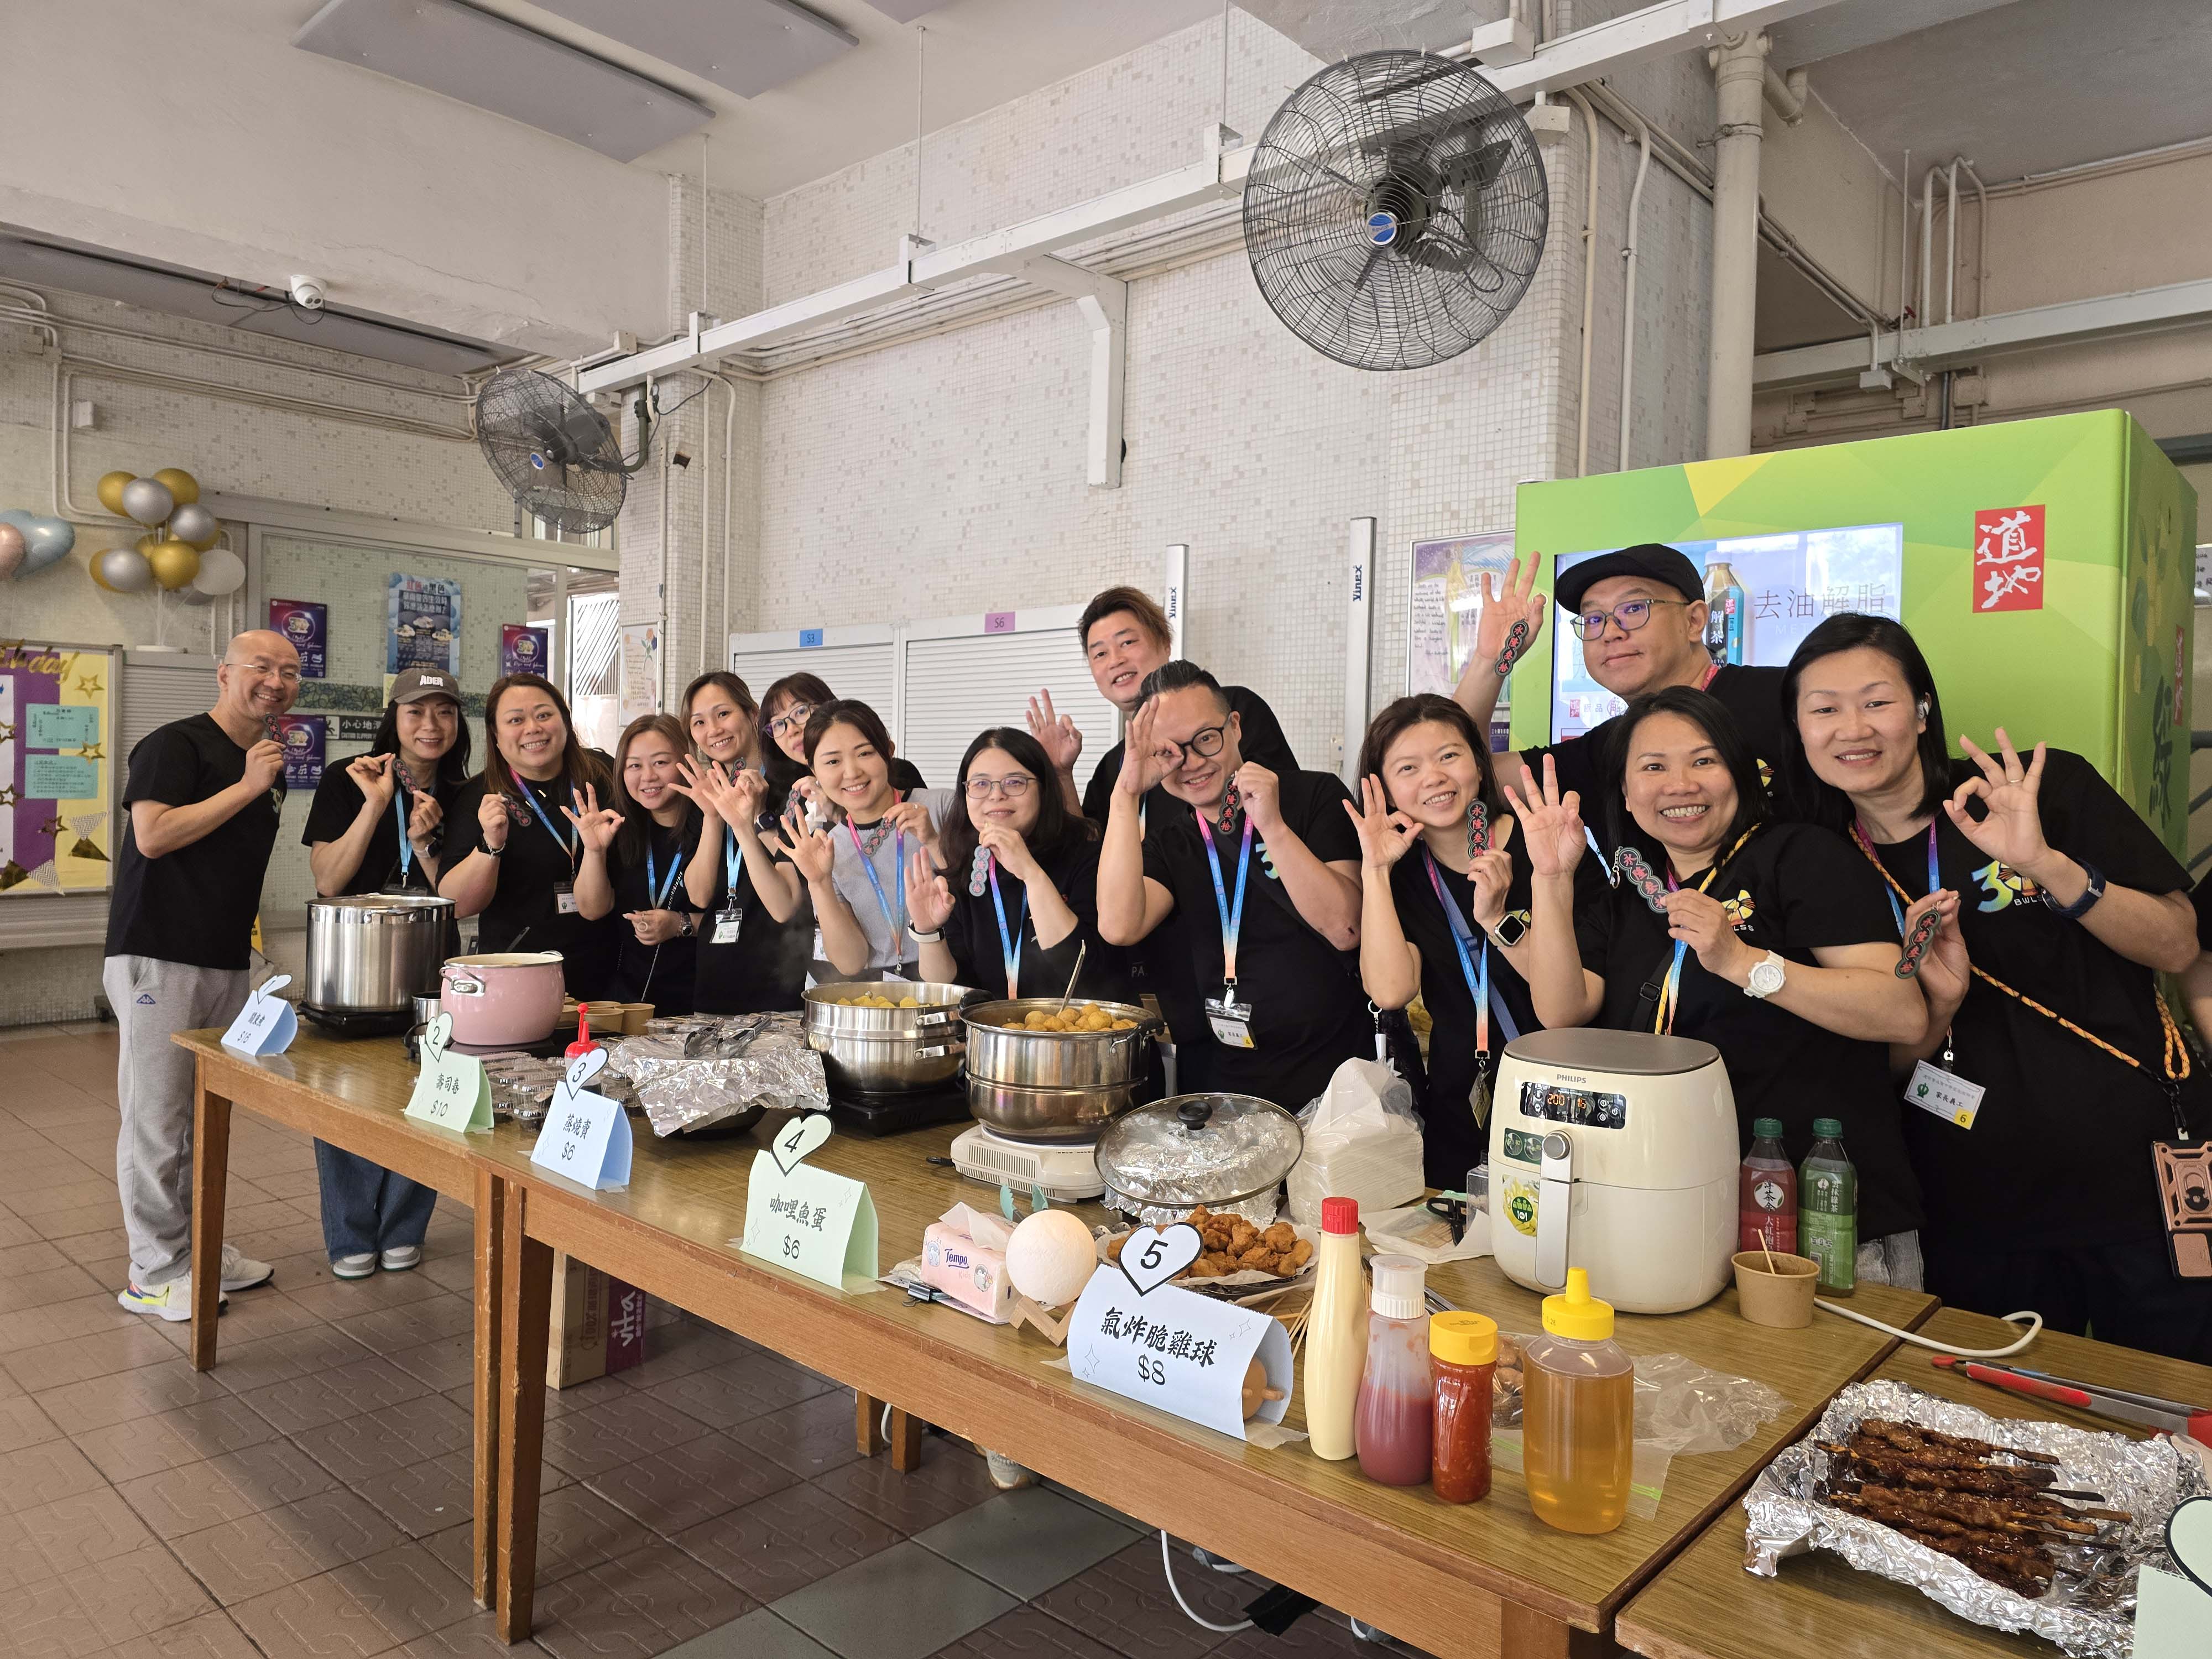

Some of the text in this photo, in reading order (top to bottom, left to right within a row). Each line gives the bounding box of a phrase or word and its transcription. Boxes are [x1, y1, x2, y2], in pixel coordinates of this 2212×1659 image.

[1976, 510, 2042, 609] 道地
[1352, 564, 1362, 602] Vinex
[994, 617, 1004, 628] S6
[806, 634, 815, 643] S3
[419, 675, 444, 687] ADER
[2014, 894, 2044, 906] BWLS
[432, 1025, 440, 1045] 2
[572, 1062, 587, 1083] 3
[1556, 1074, 1587, 1084] PHILIPS
[430, 1099, 448, 1117] $10
[1547, 1093, 1566, 1106] 200
[562, 1113, 591, 1140] 蒸燒賣
[1960, 1114, 1968, 1123] 6
[561, 1141, 576, 1161] $6
[784, 1129, 806, 1153] 4
[770, 1193, 827, 1232] 咖哩魚蛋
[1765, 1215, 1774, 1250] 大紅袍
[782, 1234, 801, 1260] $6
[945, 1248, 969, 1266] Tempo
[1140, 1239, 1168, 1270] 5
[1101, 1306, 1217, 1368] 氣炸脆雞球
[1138, 1353, 1166, 1386] $8
